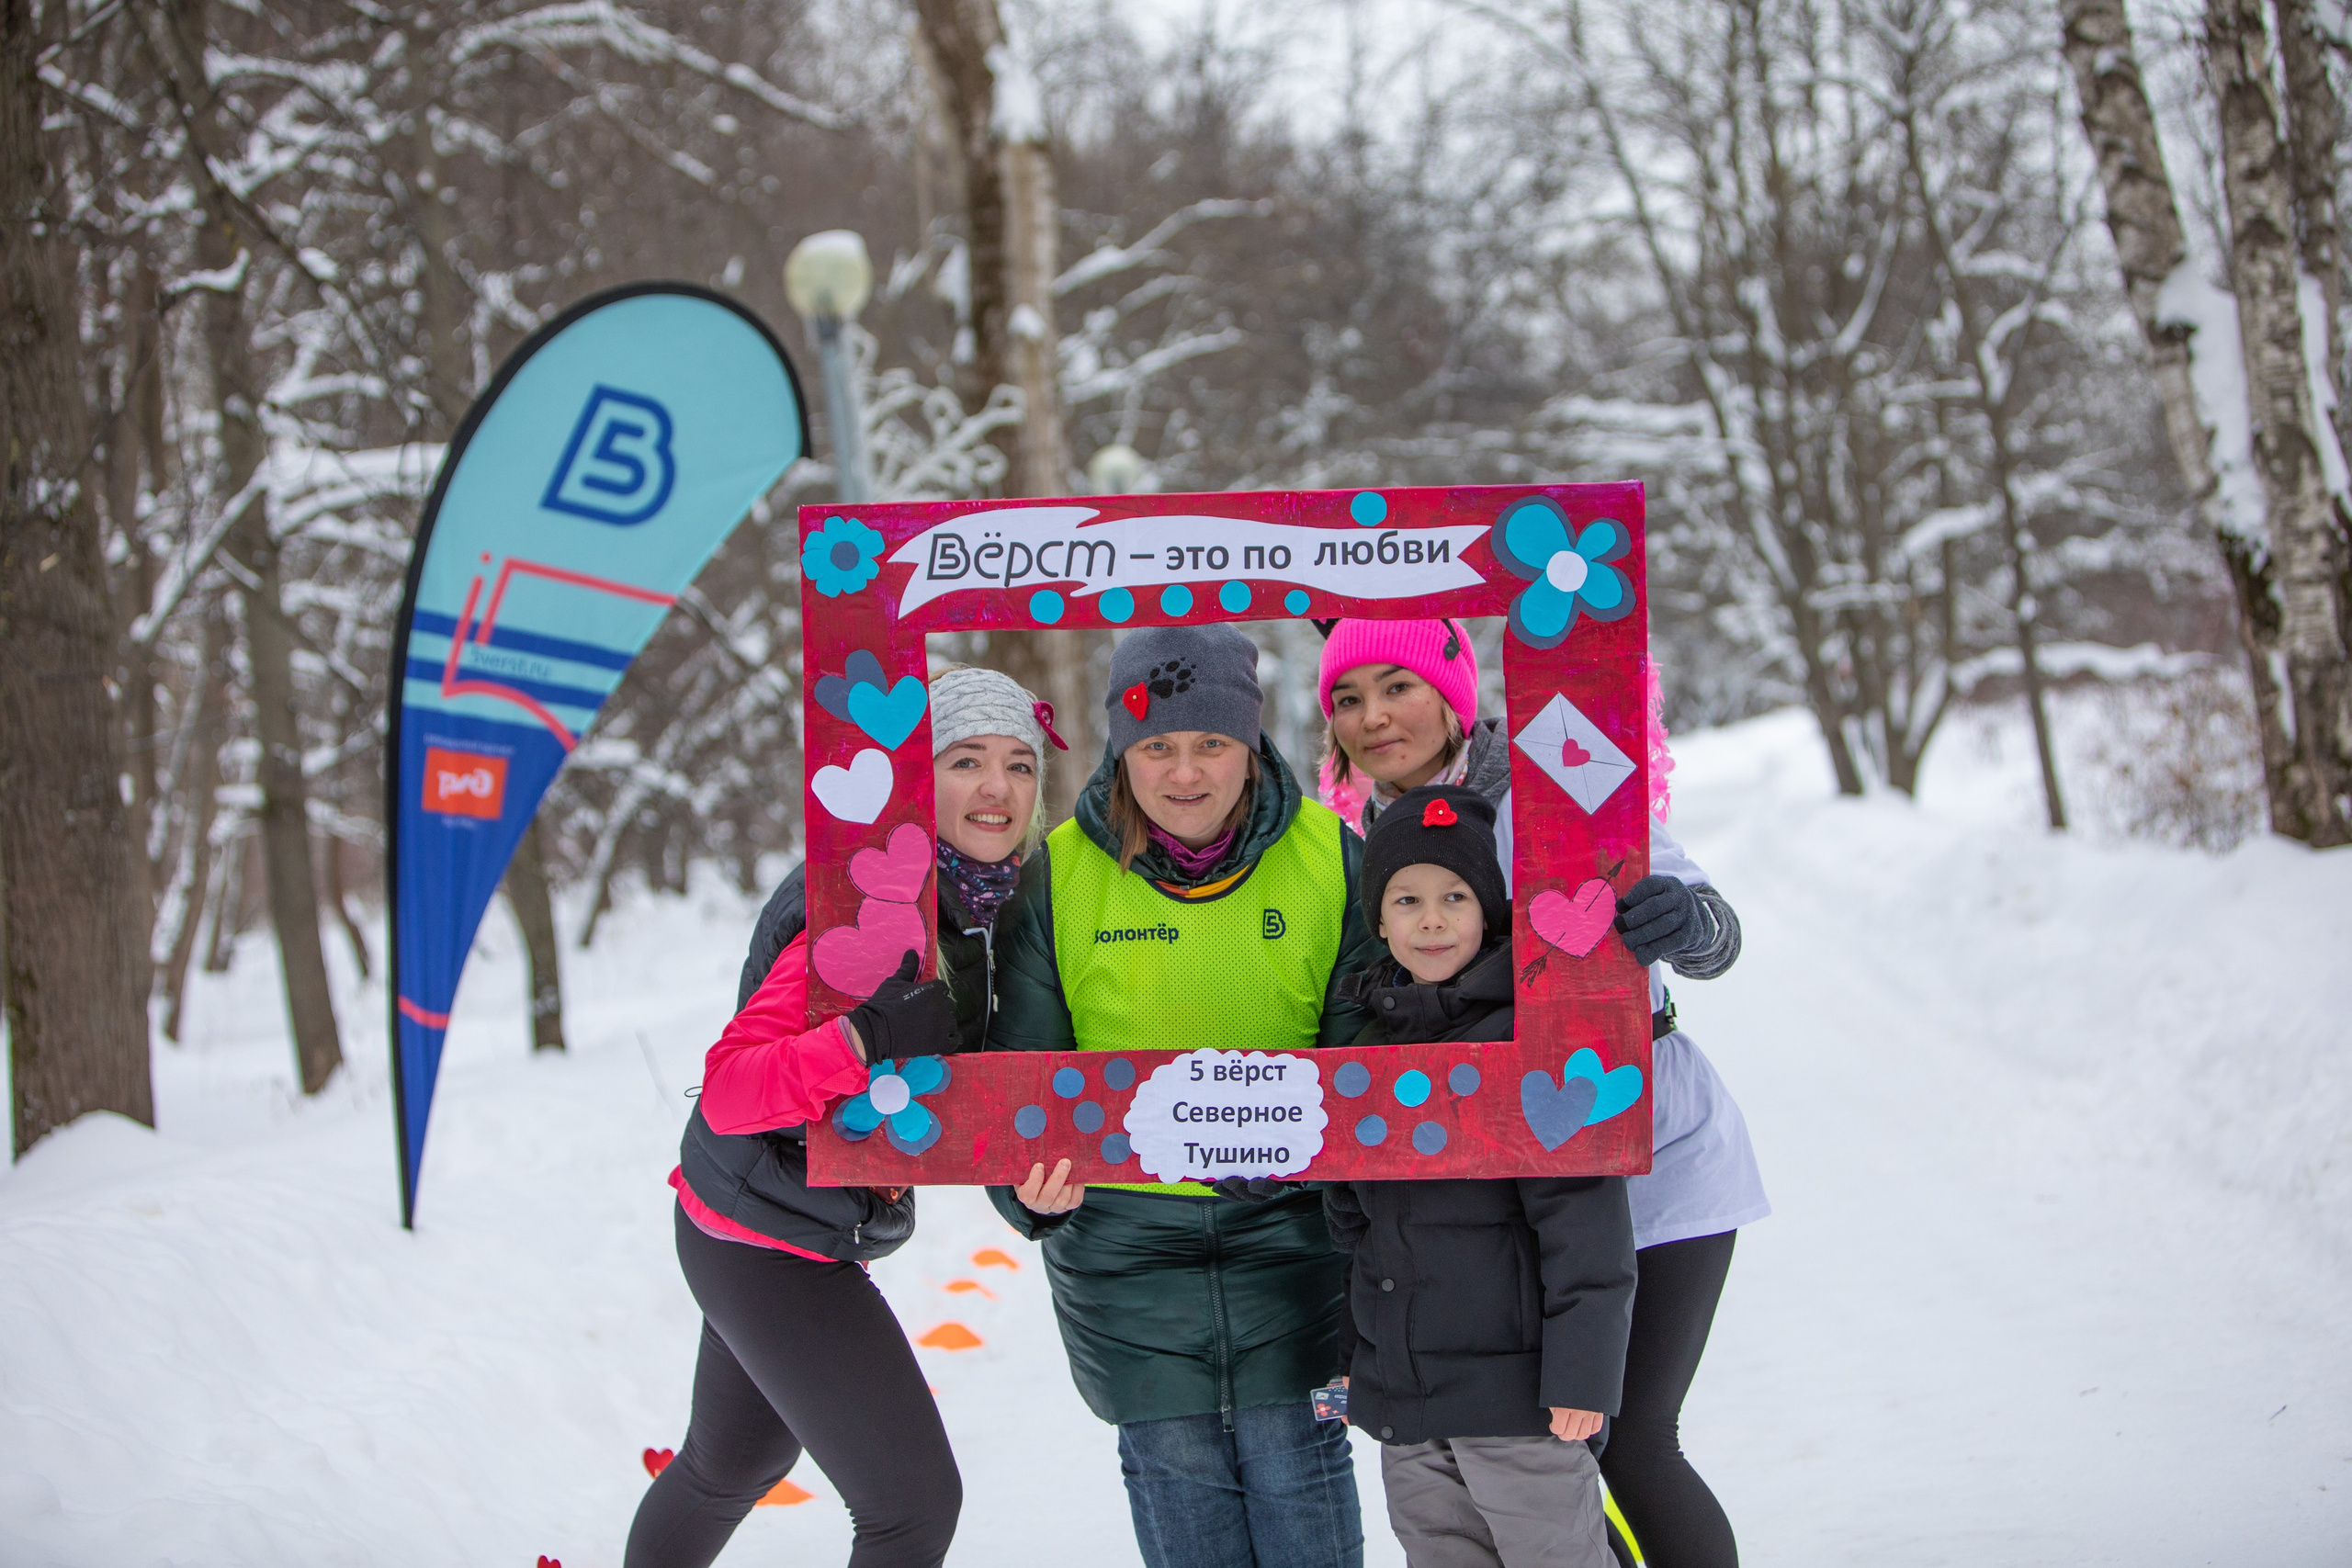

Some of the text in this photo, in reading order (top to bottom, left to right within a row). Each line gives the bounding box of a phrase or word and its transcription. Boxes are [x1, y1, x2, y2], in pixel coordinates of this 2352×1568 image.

[1166, 546, 1230, 570] это
[1243, 545, 1292, 570] по
[1314, 529, 1450, 566] любви
[1190, 1058, 1287, 1087] 5 вёрст
[1171, 1100, 1303, 1128] Северное
[1183, 1142, 1291, 1169] Тушино
